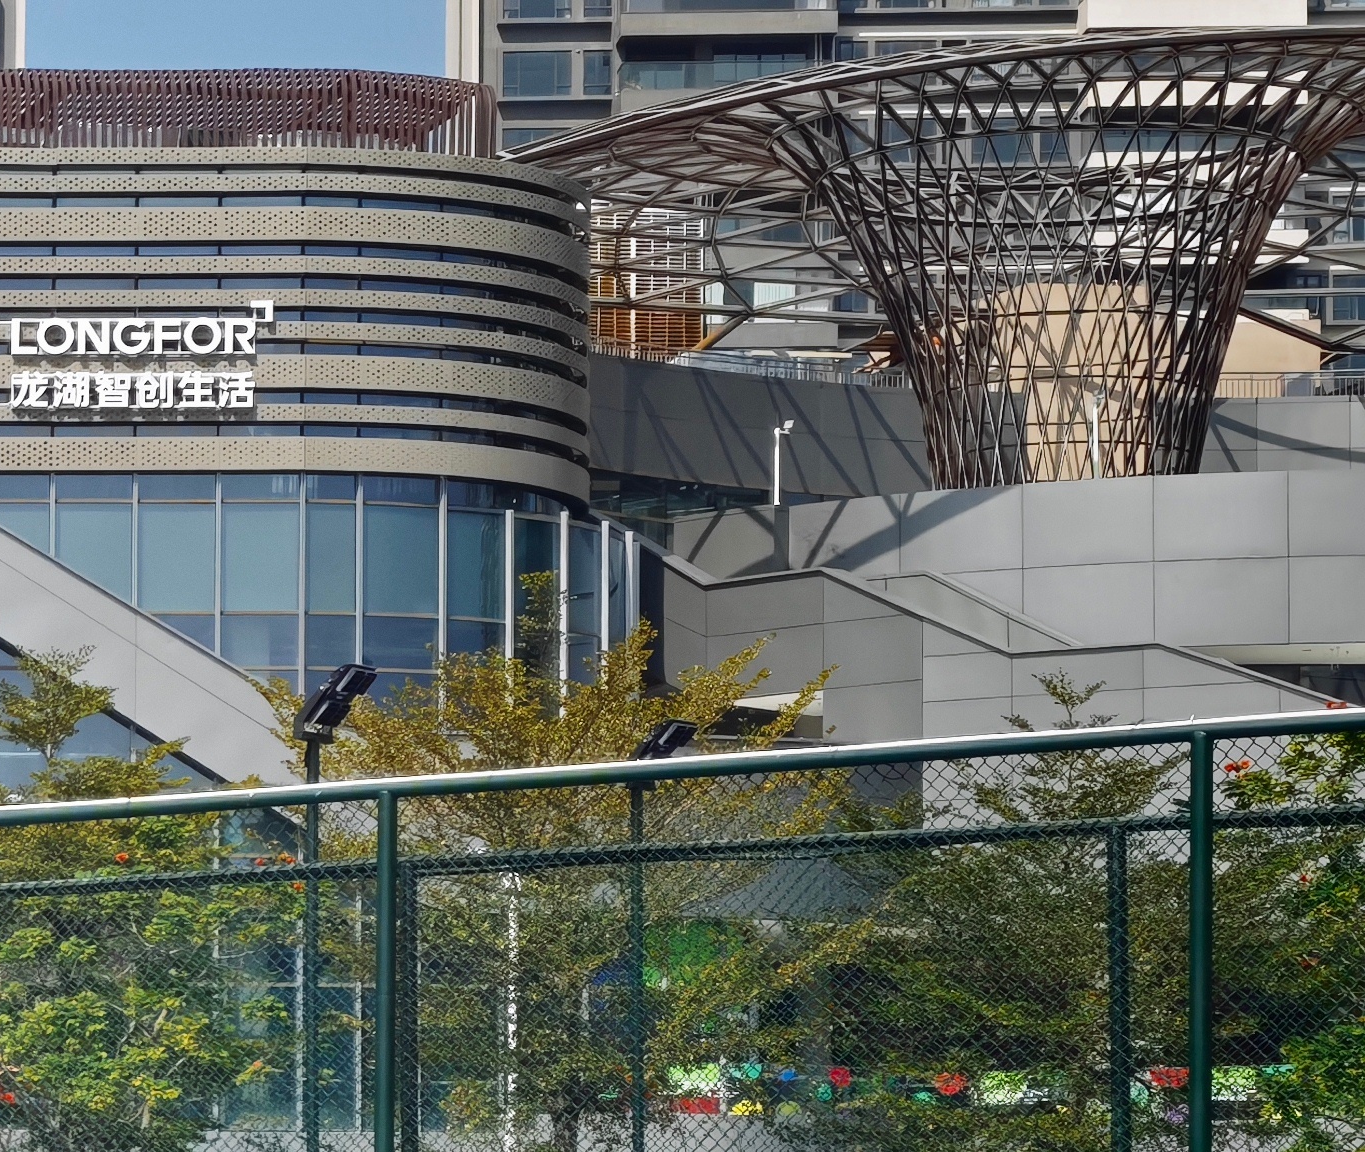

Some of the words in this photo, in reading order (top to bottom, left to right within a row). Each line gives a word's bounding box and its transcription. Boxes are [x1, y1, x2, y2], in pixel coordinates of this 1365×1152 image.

[10, 317, 257, 355] LONGFOR
[10, 370, 257, 409] 龙湖智创生活
